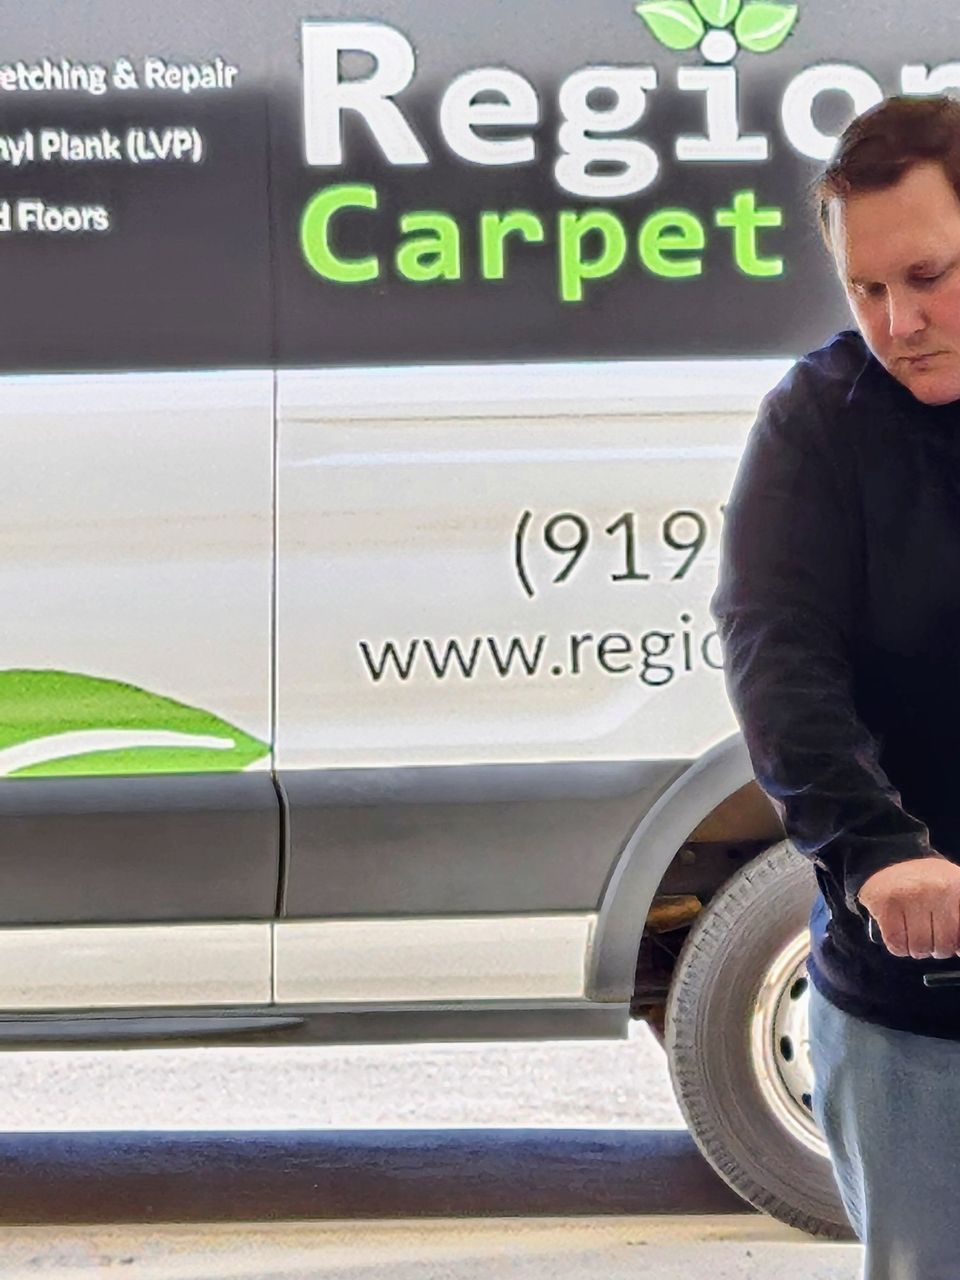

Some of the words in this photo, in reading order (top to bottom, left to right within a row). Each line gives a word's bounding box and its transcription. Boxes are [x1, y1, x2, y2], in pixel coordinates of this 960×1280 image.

[112, 57, 139, 90] &
[144, 56, 239, 94] Repair
[41, 129, 122, 161] Plank
[127, 127, 203, 164] (LVP)
[18, 199, 110, 232] Floors
[303, 185, 784, 301] Carpet
[515, 509, 725, 598] (919
